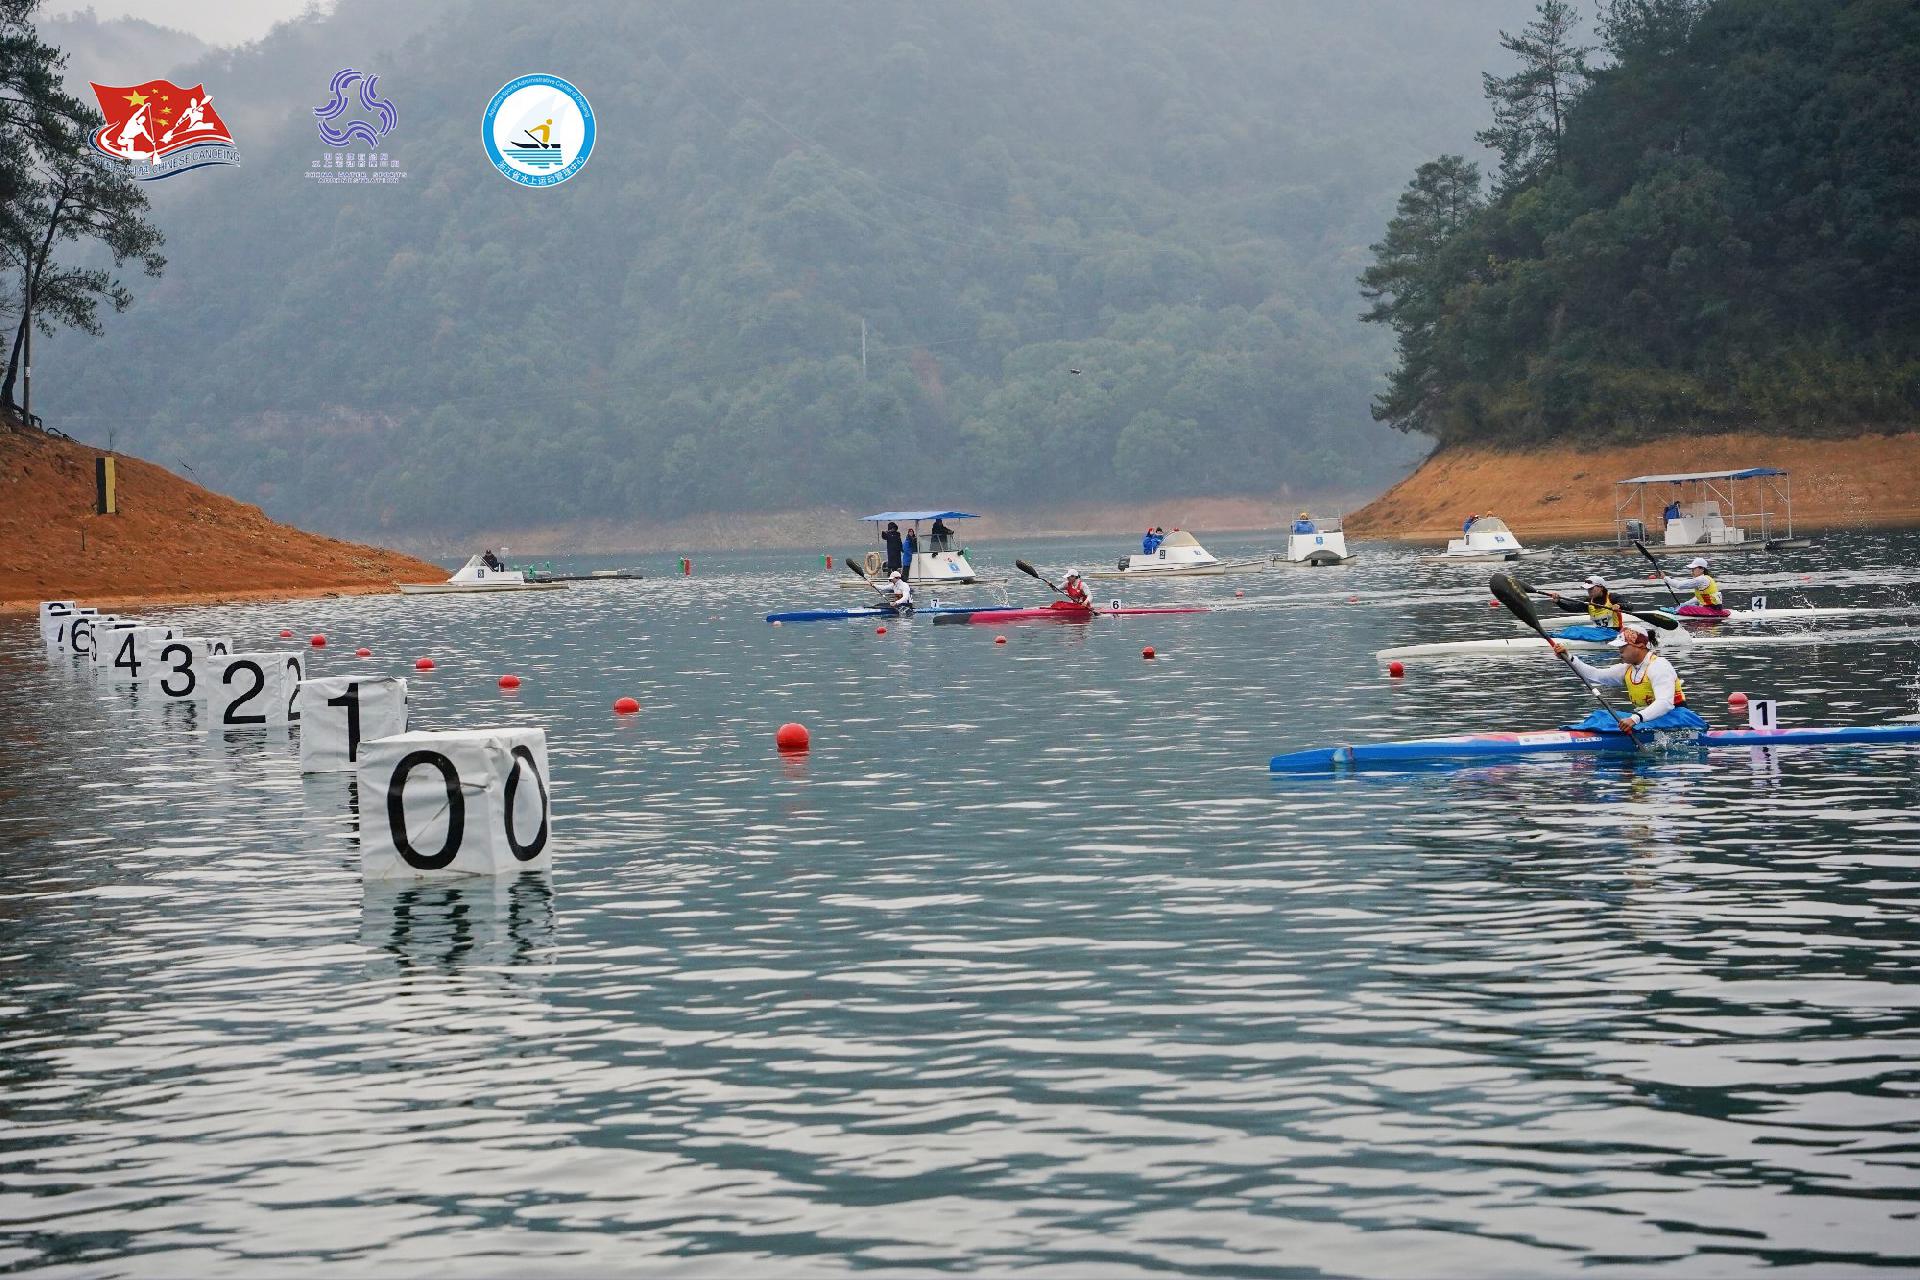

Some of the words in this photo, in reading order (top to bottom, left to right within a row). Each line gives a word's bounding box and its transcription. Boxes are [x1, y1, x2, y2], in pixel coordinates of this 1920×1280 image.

[1112, 600, 1120, 610] 6
[1753, 597, 1763, 610] 4
[71, 618, 90, 653] 6
[115, 633, 141, 677] 4
[160, 643, 196, 697] 3
[222, 660, 266, 724] 2
[327, 682, 360, 763] 1
[1756, 701, 1769, 726] 1
[387, 750, 465, 870] 0
[504, 744, 548, 862] 0
